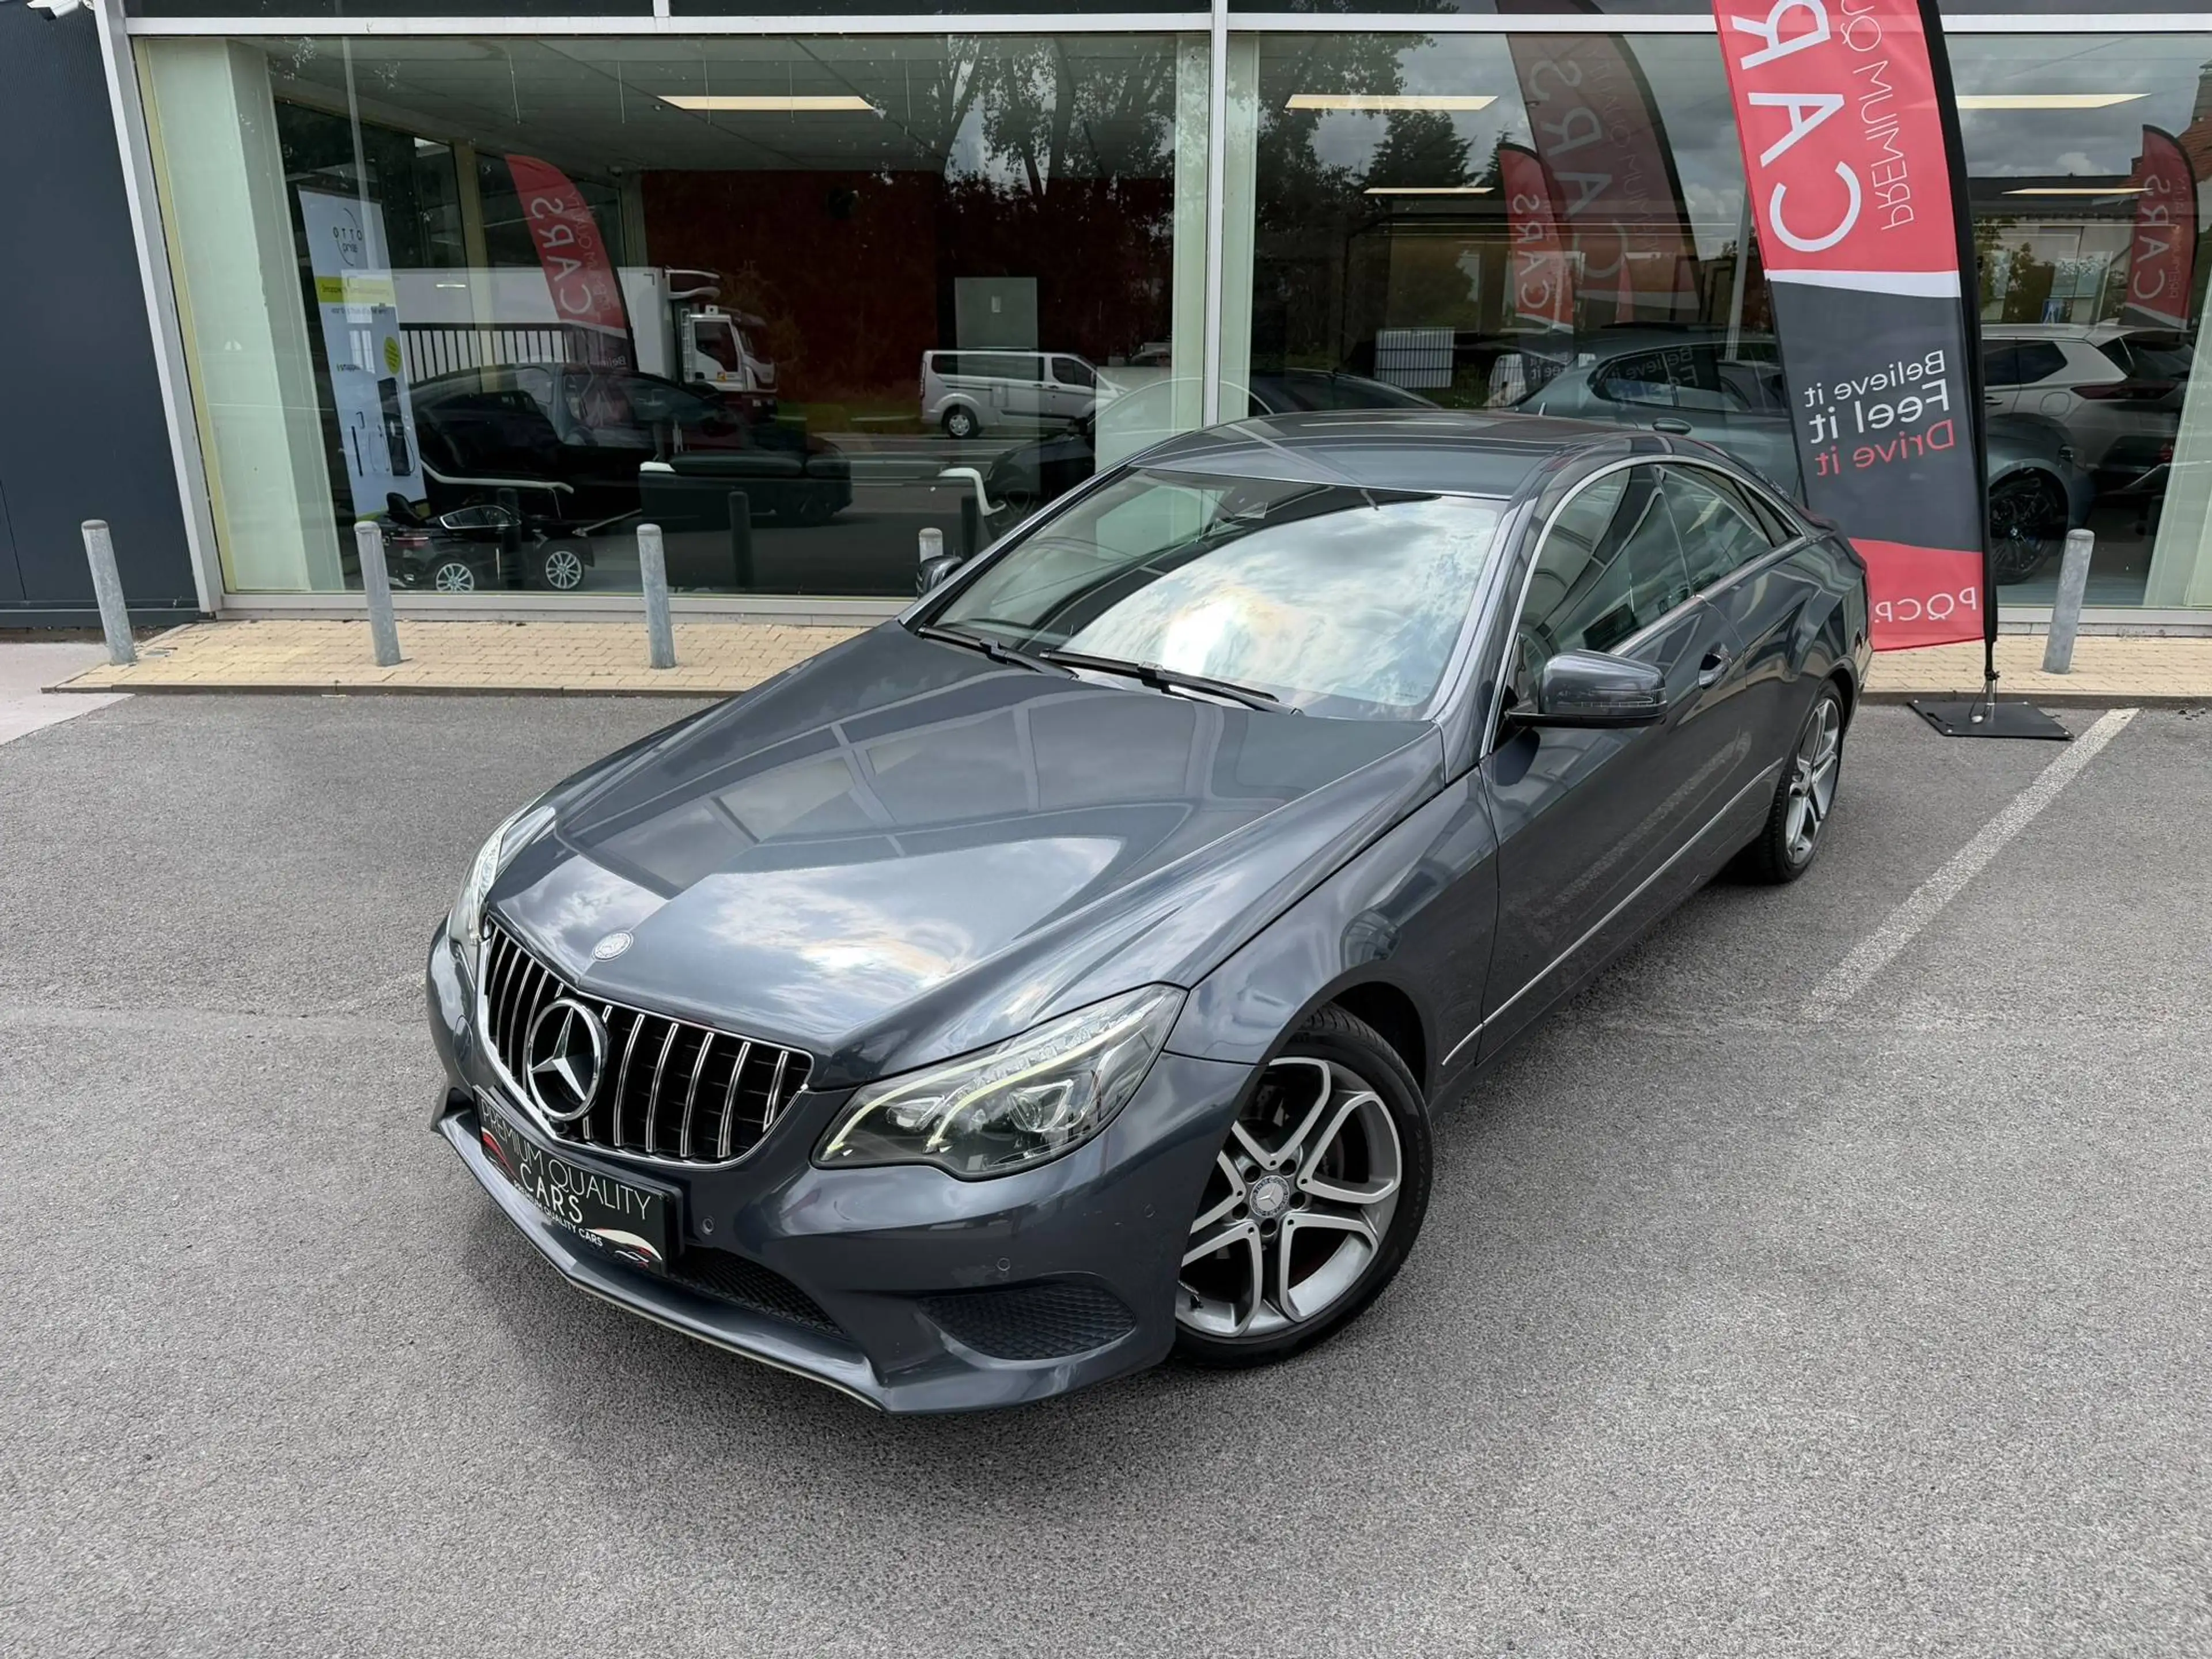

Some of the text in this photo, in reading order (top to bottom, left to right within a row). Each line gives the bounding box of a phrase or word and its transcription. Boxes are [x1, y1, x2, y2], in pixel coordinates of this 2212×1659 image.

[333, 226, 362, 241] OTTO
[480, 1098, 651, 1220] PREMIUM QUALITY
[520, 1162, 583, 1224] CARS
[544, 1206, 576, 1233] QUALITY
[578, 1228, 603, 1247] CARS
